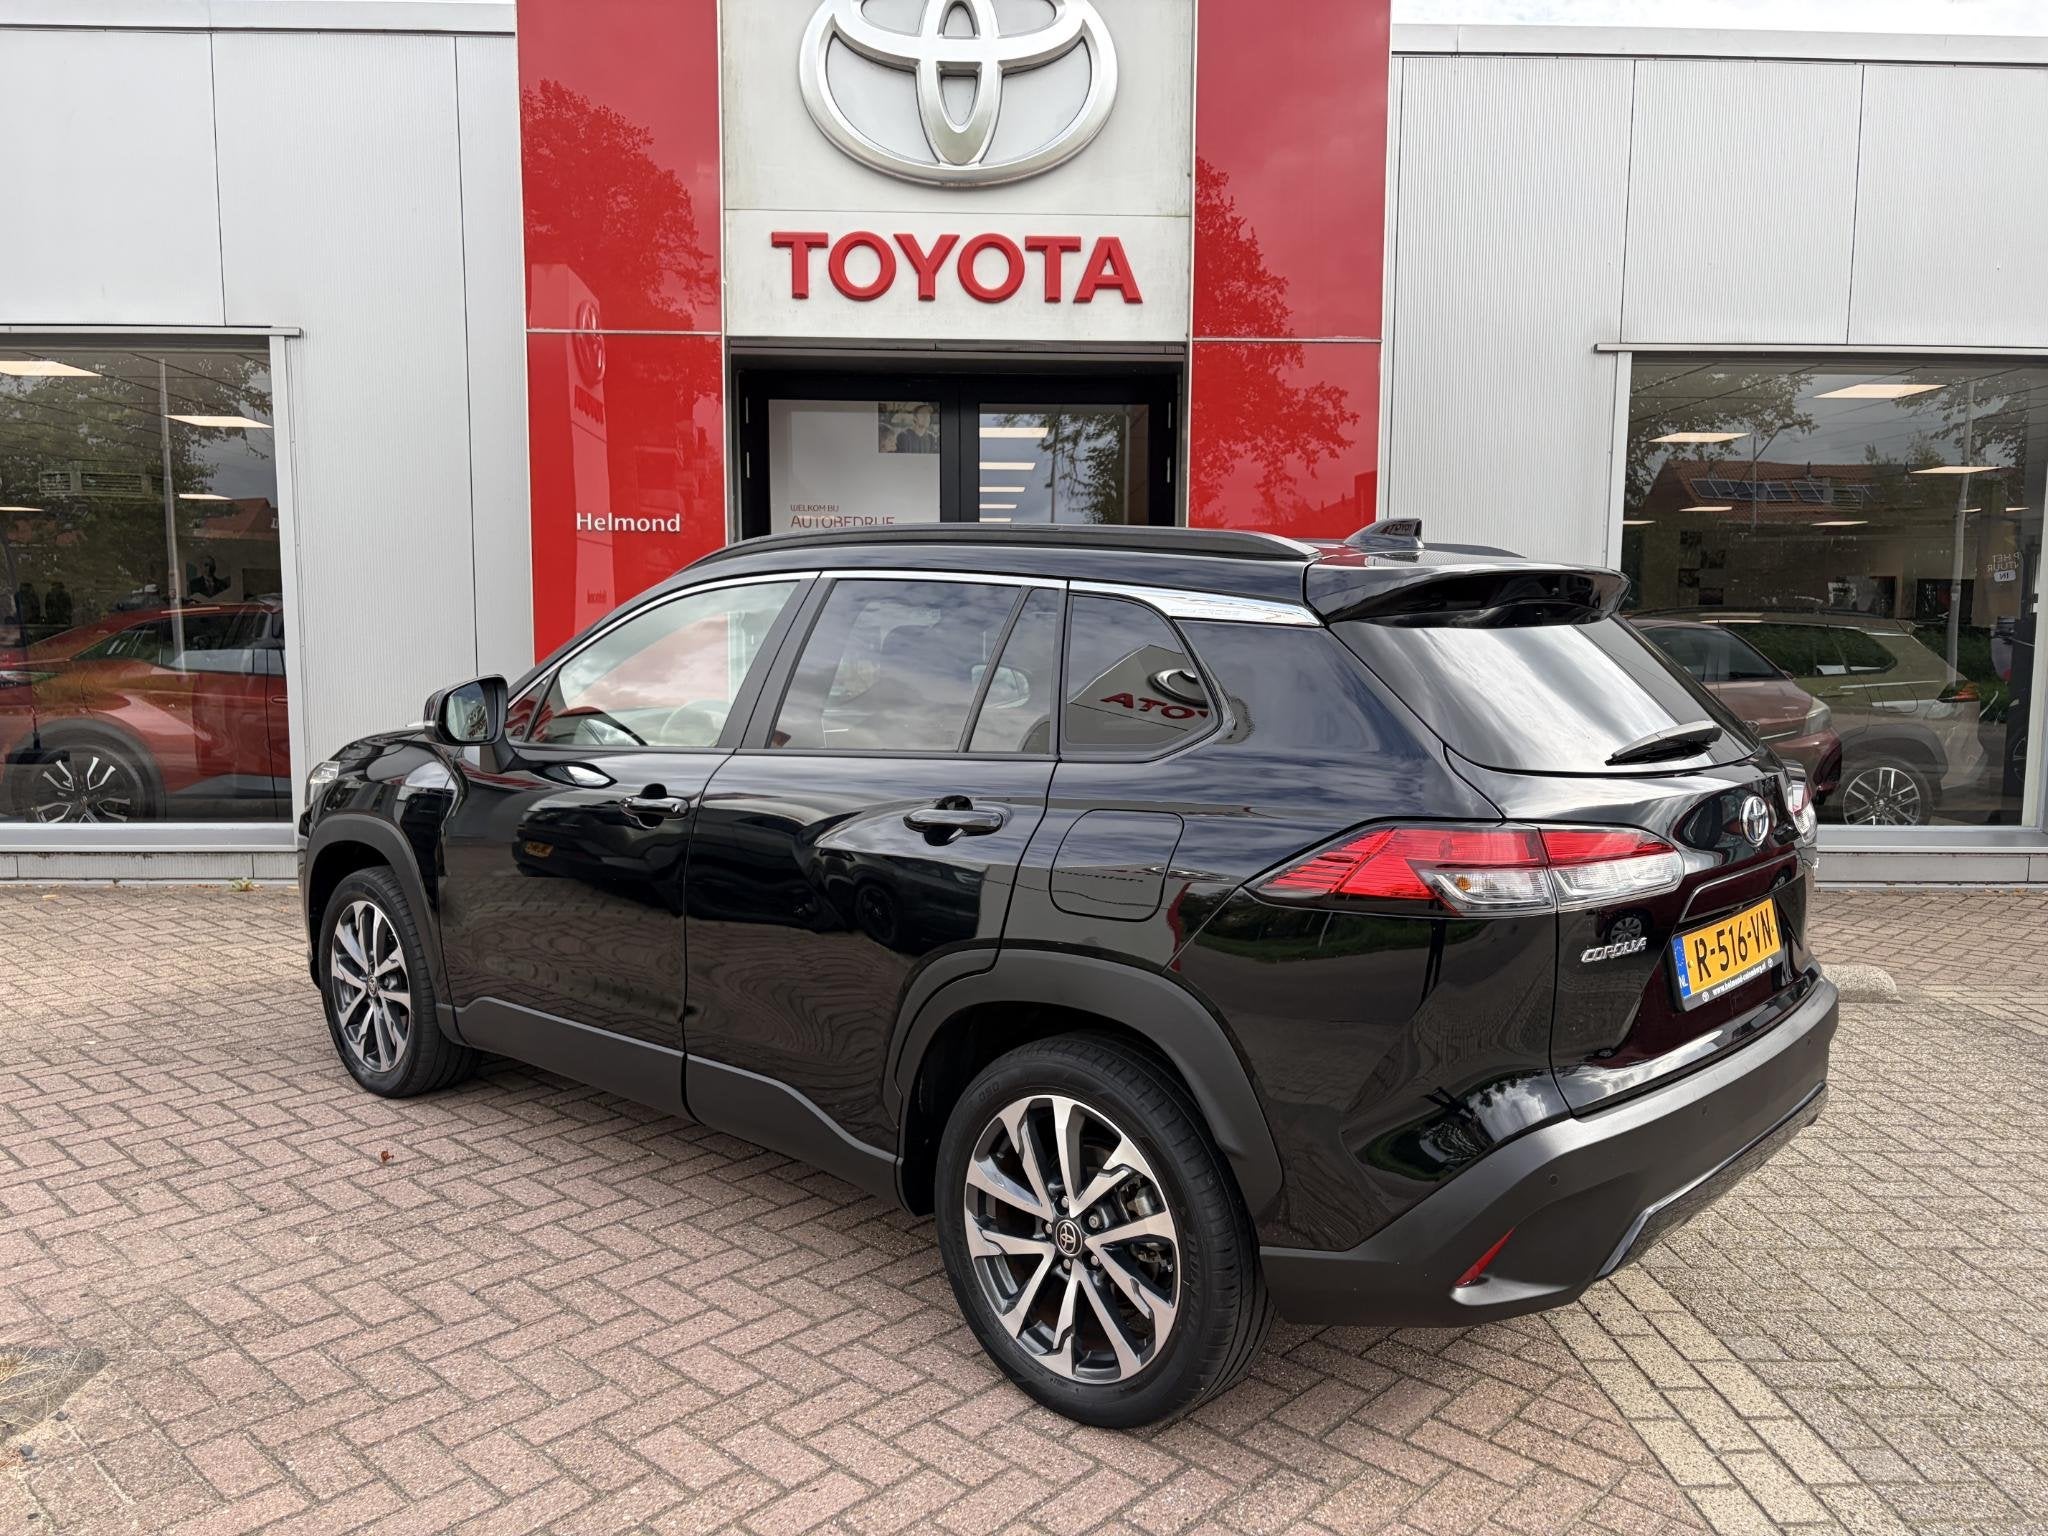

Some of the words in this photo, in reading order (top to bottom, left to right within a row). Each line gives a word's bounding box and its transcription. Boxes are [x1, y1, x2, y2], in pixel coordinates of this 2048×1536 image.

[771, 231, 1143, 304] TOYOTA
[790, 504, 826, 513] WELKOM
[576, 512, 681, 532] Helmond
[1580, 937, 1647, 963] COROLLA
[1694, 907, 1773, 982] R-516-VN
[1678, 974, 1688, 988] NL
